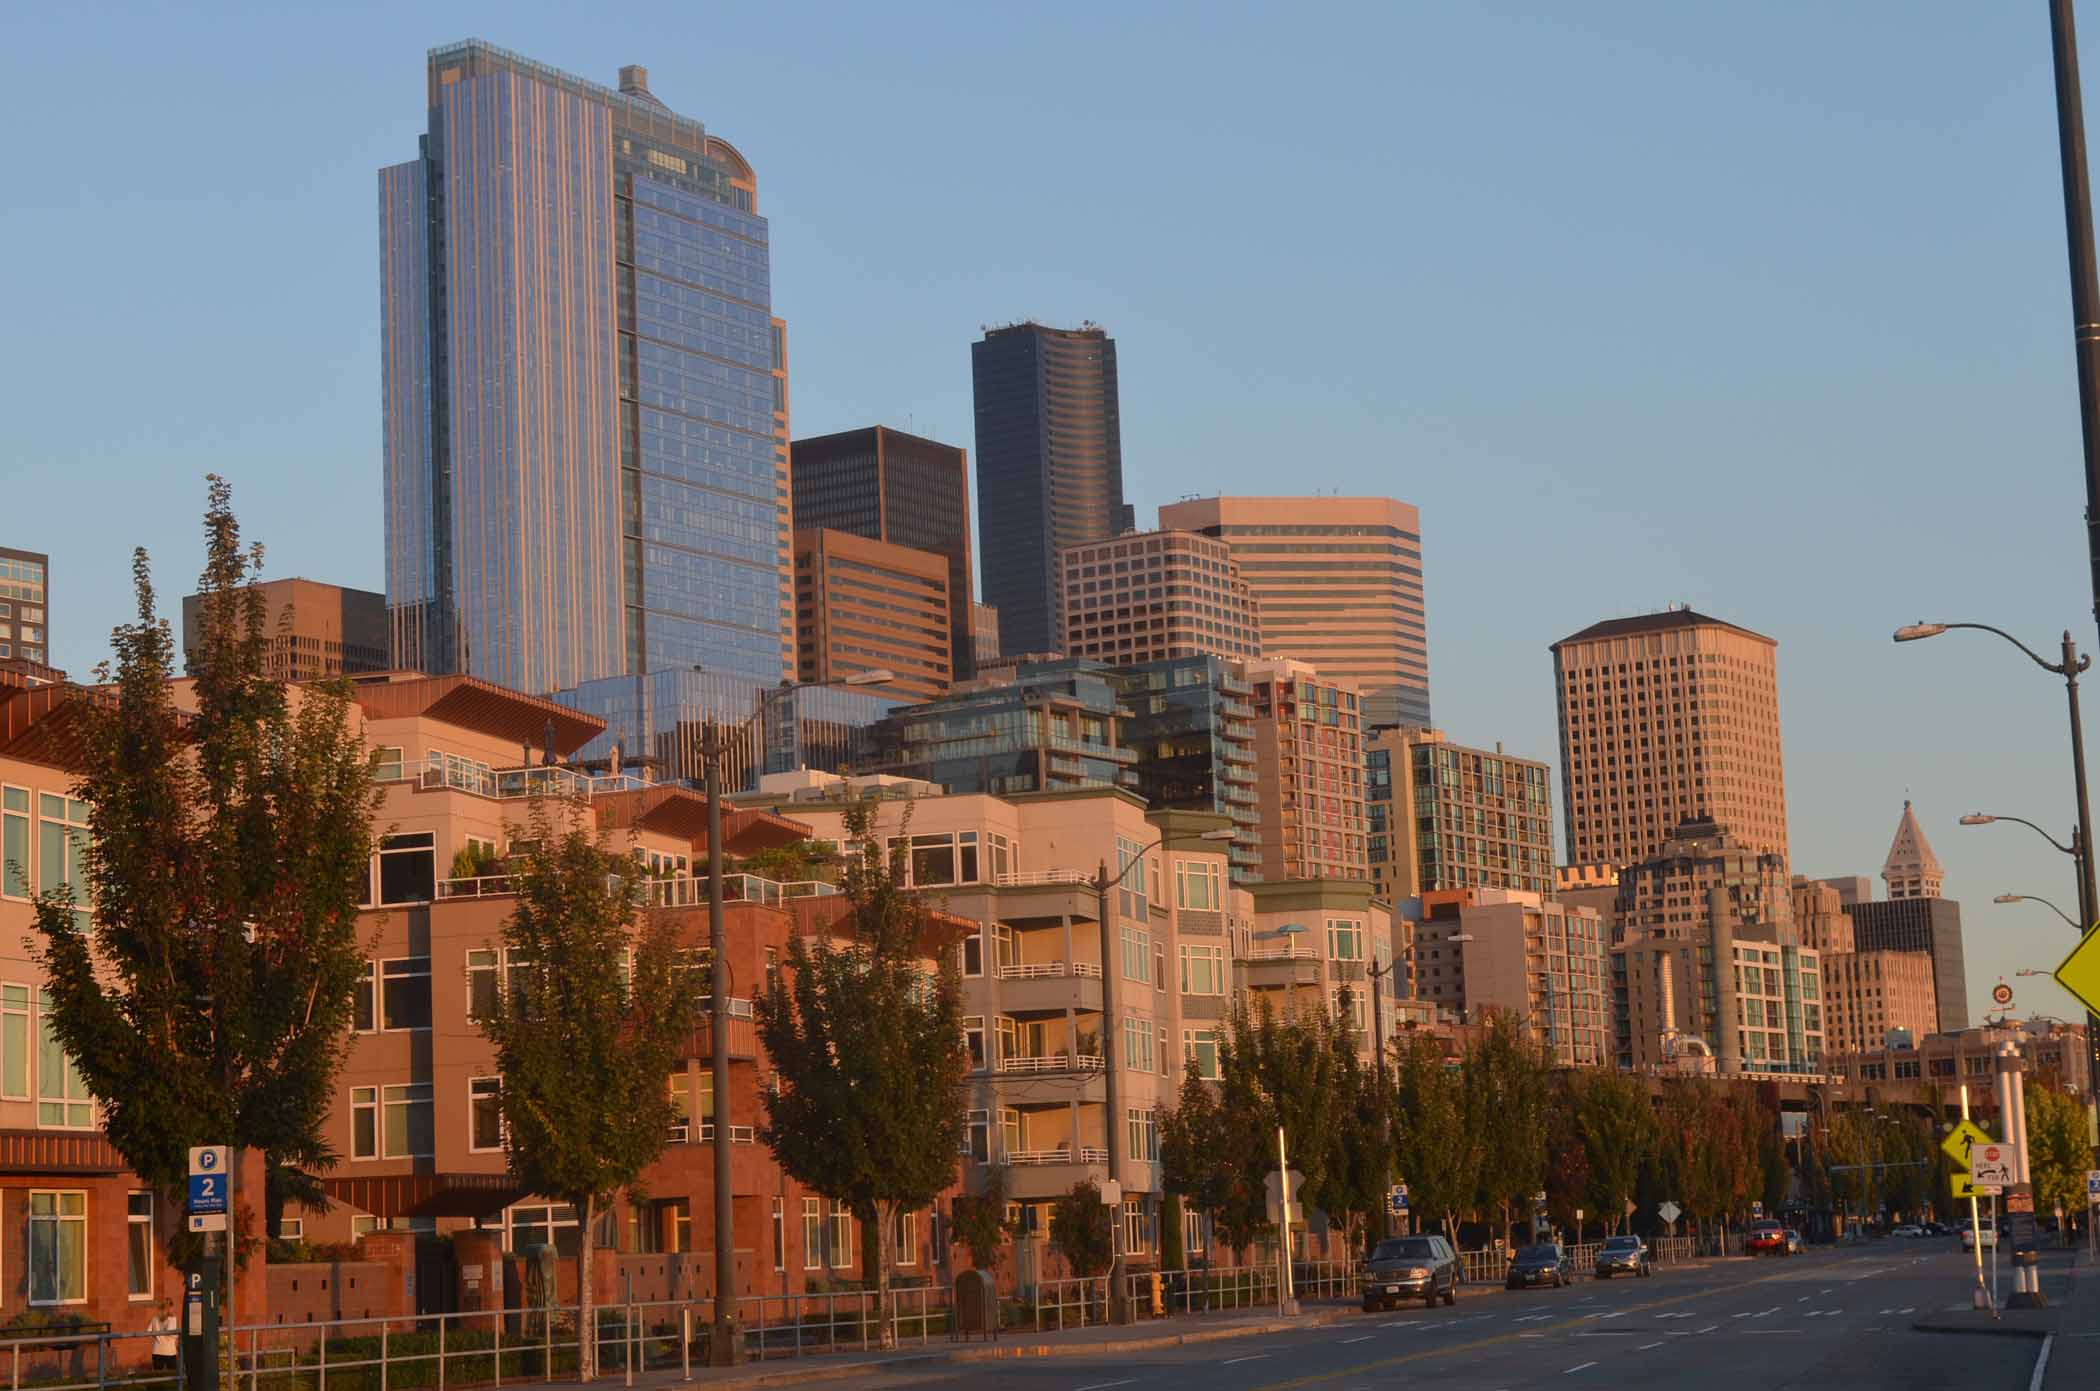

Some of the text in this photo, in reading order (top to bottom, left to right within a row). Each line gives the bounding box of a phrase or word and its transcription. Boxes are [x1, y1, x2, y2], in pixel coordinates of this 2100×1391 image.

[203, 1153, 213, 1167] P
[202, 1178, 214, 1196] 2
[191, 1273, 201, 1288] P
